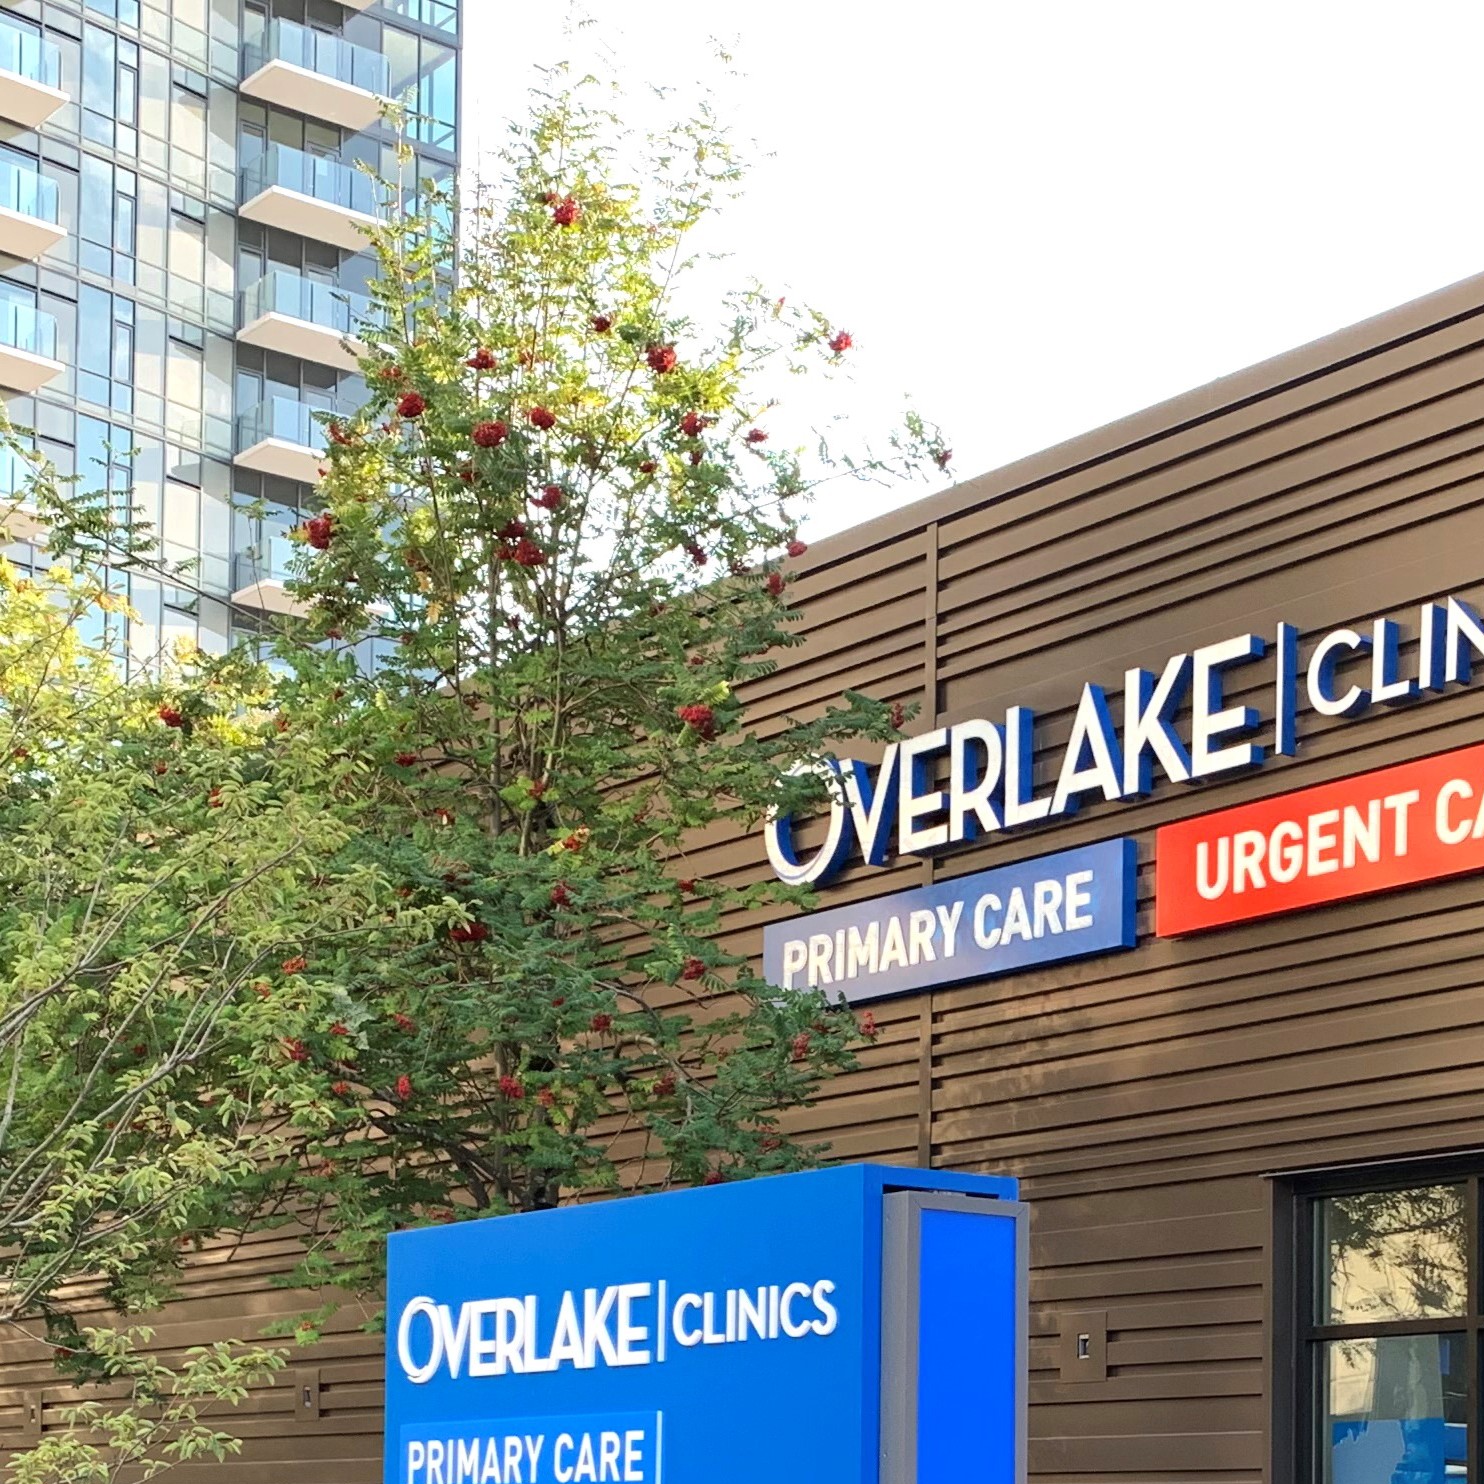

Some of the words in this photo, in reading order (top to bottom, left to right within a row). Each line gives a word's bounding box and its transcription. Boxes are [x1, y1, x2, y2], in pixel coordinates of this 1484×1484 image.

[764, 635, 1258, 886] OVERLAKE
[1196, 792, 1419, 900] URGENT
[783, 901, 964, 989] PRIMARY
[973, 869, 1095, 950] CARE
[398, 1281, 652, 1384] OVERLAKE
[673, 1279, 838, 1347] CLINICS
[553, 1430, 645, 1483] CARE
